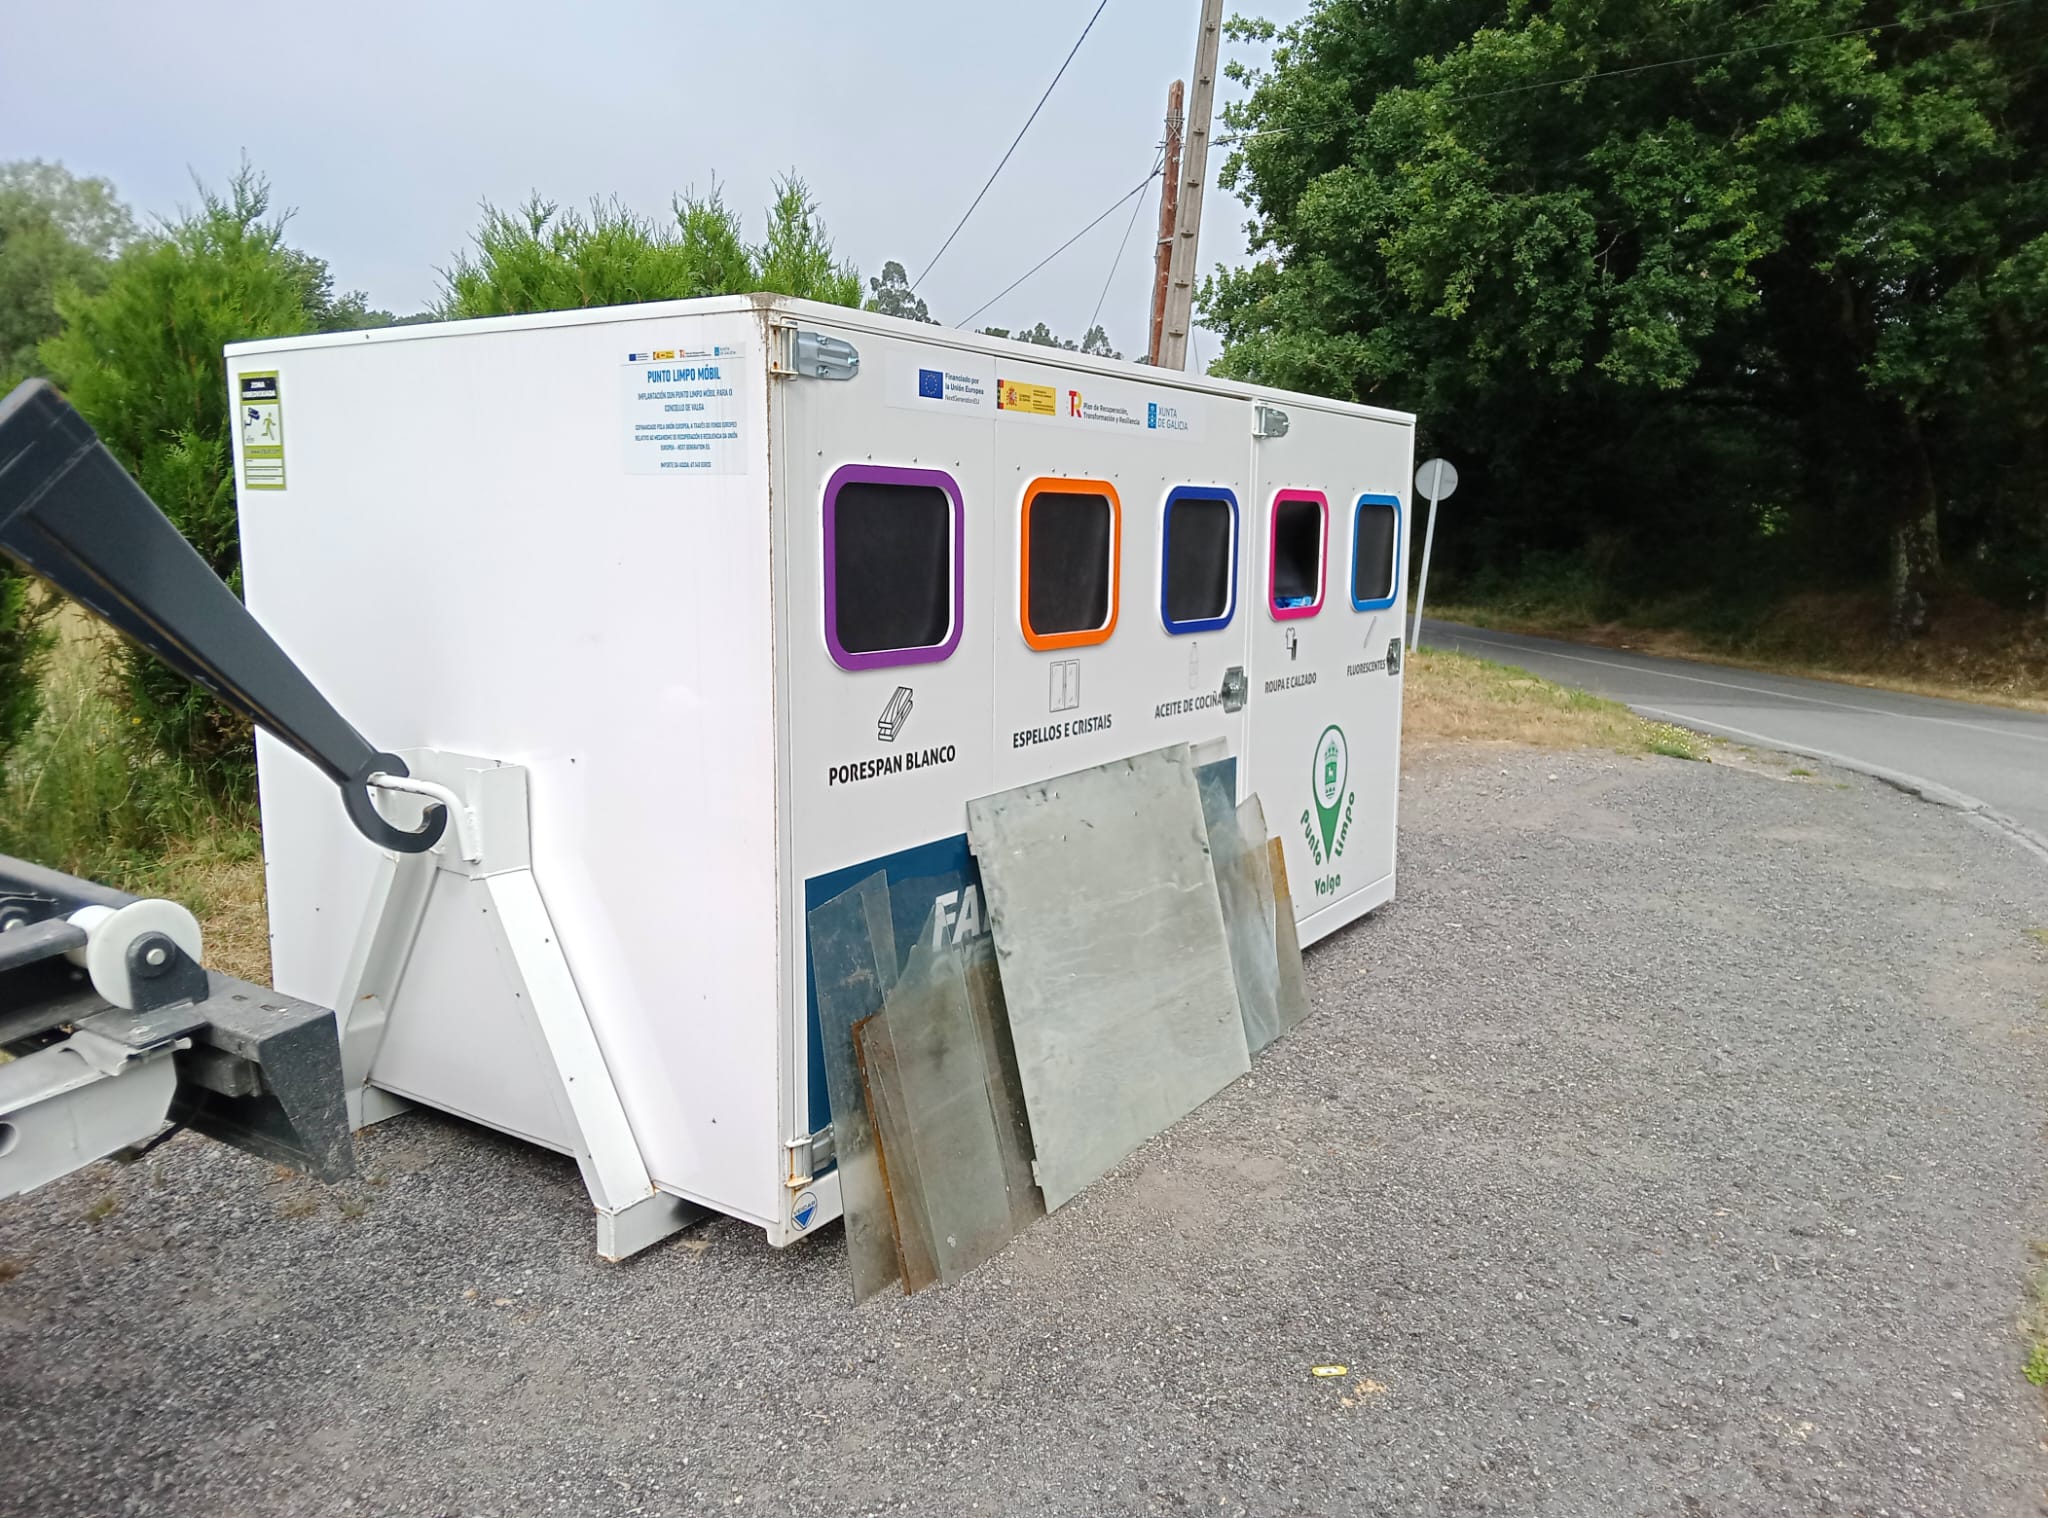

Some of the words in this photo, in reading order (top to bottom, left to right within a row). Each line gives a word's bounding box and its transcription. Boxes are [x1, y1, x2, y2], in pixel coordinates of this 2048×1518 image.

[647, 369, 671, 384] PUNTO
[673, 367, 696, 382] LIMPO
[697, 363, 721, 380] MÓBIL
[945, 372, 971, 383] Financiado
[950, 383, 965, 392] Unión
[965, 385, 984, 395] Europea
[1158, 407, 1177, 418] XUNTA
[1158, 418, 1166, 428] DE
[1166, 419, 1189, 431] GALICIA
[1347, 659, 1386, 677] FLUORESCENTES
[1265, 679, 1285, 694] ROUPA
[1286, 678, 1290, 690] E
[1291, 672, 1317, 688] CALZADO
[1154, 700, 1182, 719] ACEITE
[1183, 698, 1194, 713] DE
[1195, 691, 1222, 710] COCIÑA
[1012, 724, 1062, 748] ESPELLOS
[1064, 722, 1070, 736] E
[1072, 714, 1112, 735] CRISTAIS
[829, 754, 902, 786] PORESPAN
[906, 744, 956, 771] BLANCO
[1334, 791, 1355, 857] Limpo
[1300, 808, 1321, 866] Punto
